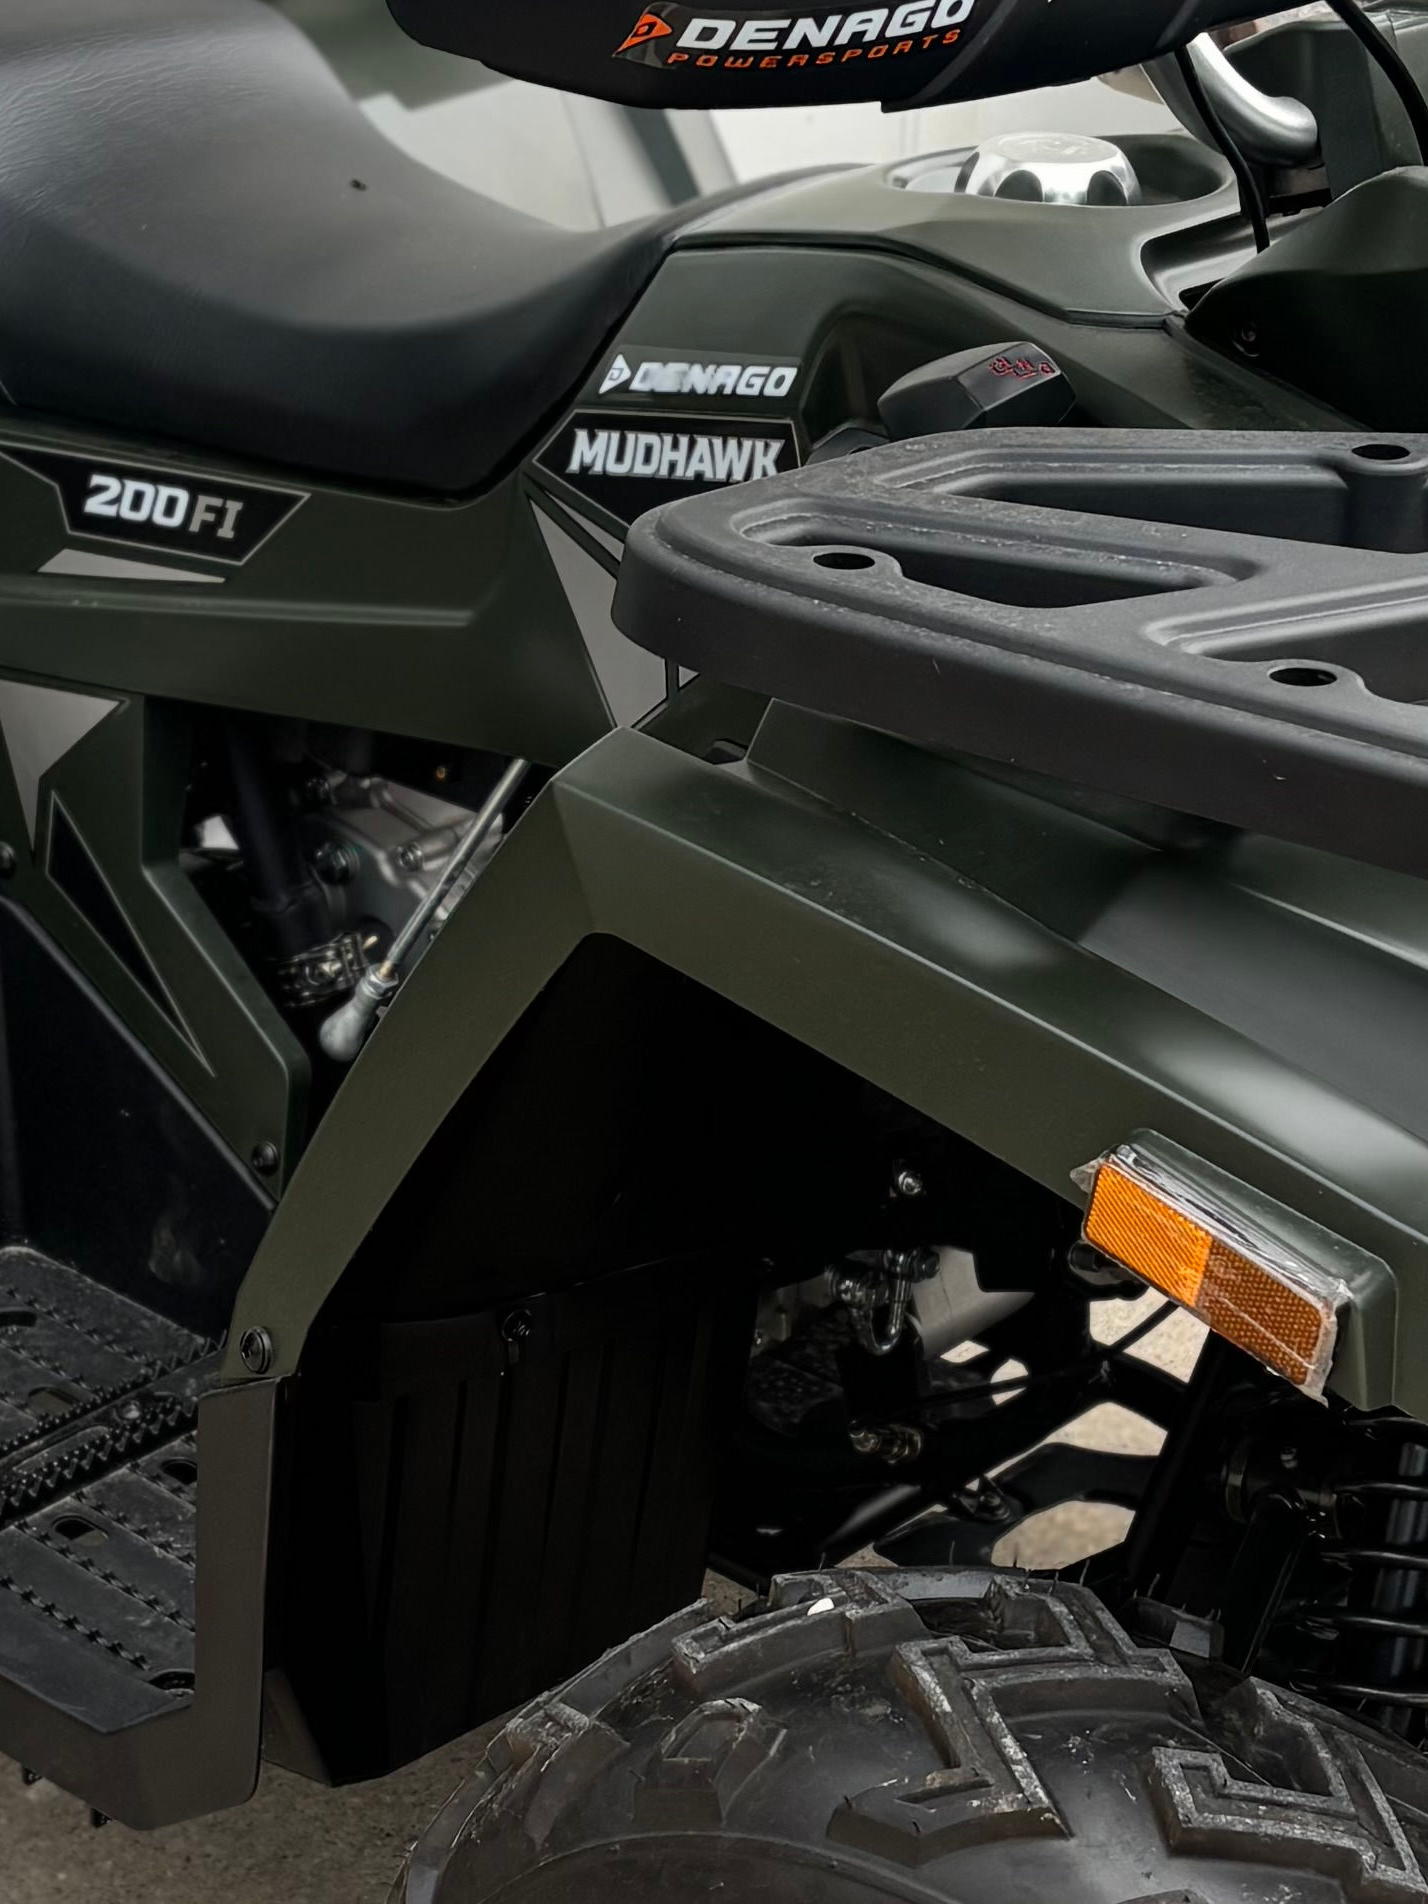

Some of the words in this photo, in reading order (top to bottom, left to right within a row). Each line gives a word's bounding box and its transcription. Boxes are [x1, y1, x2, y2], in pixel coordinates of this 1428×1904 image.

[667, 28, 961, 69] POWERSPORTS
[629, 361, 799, 397] DENAGO
[565, 428, 786, 483] MUDHAWK
